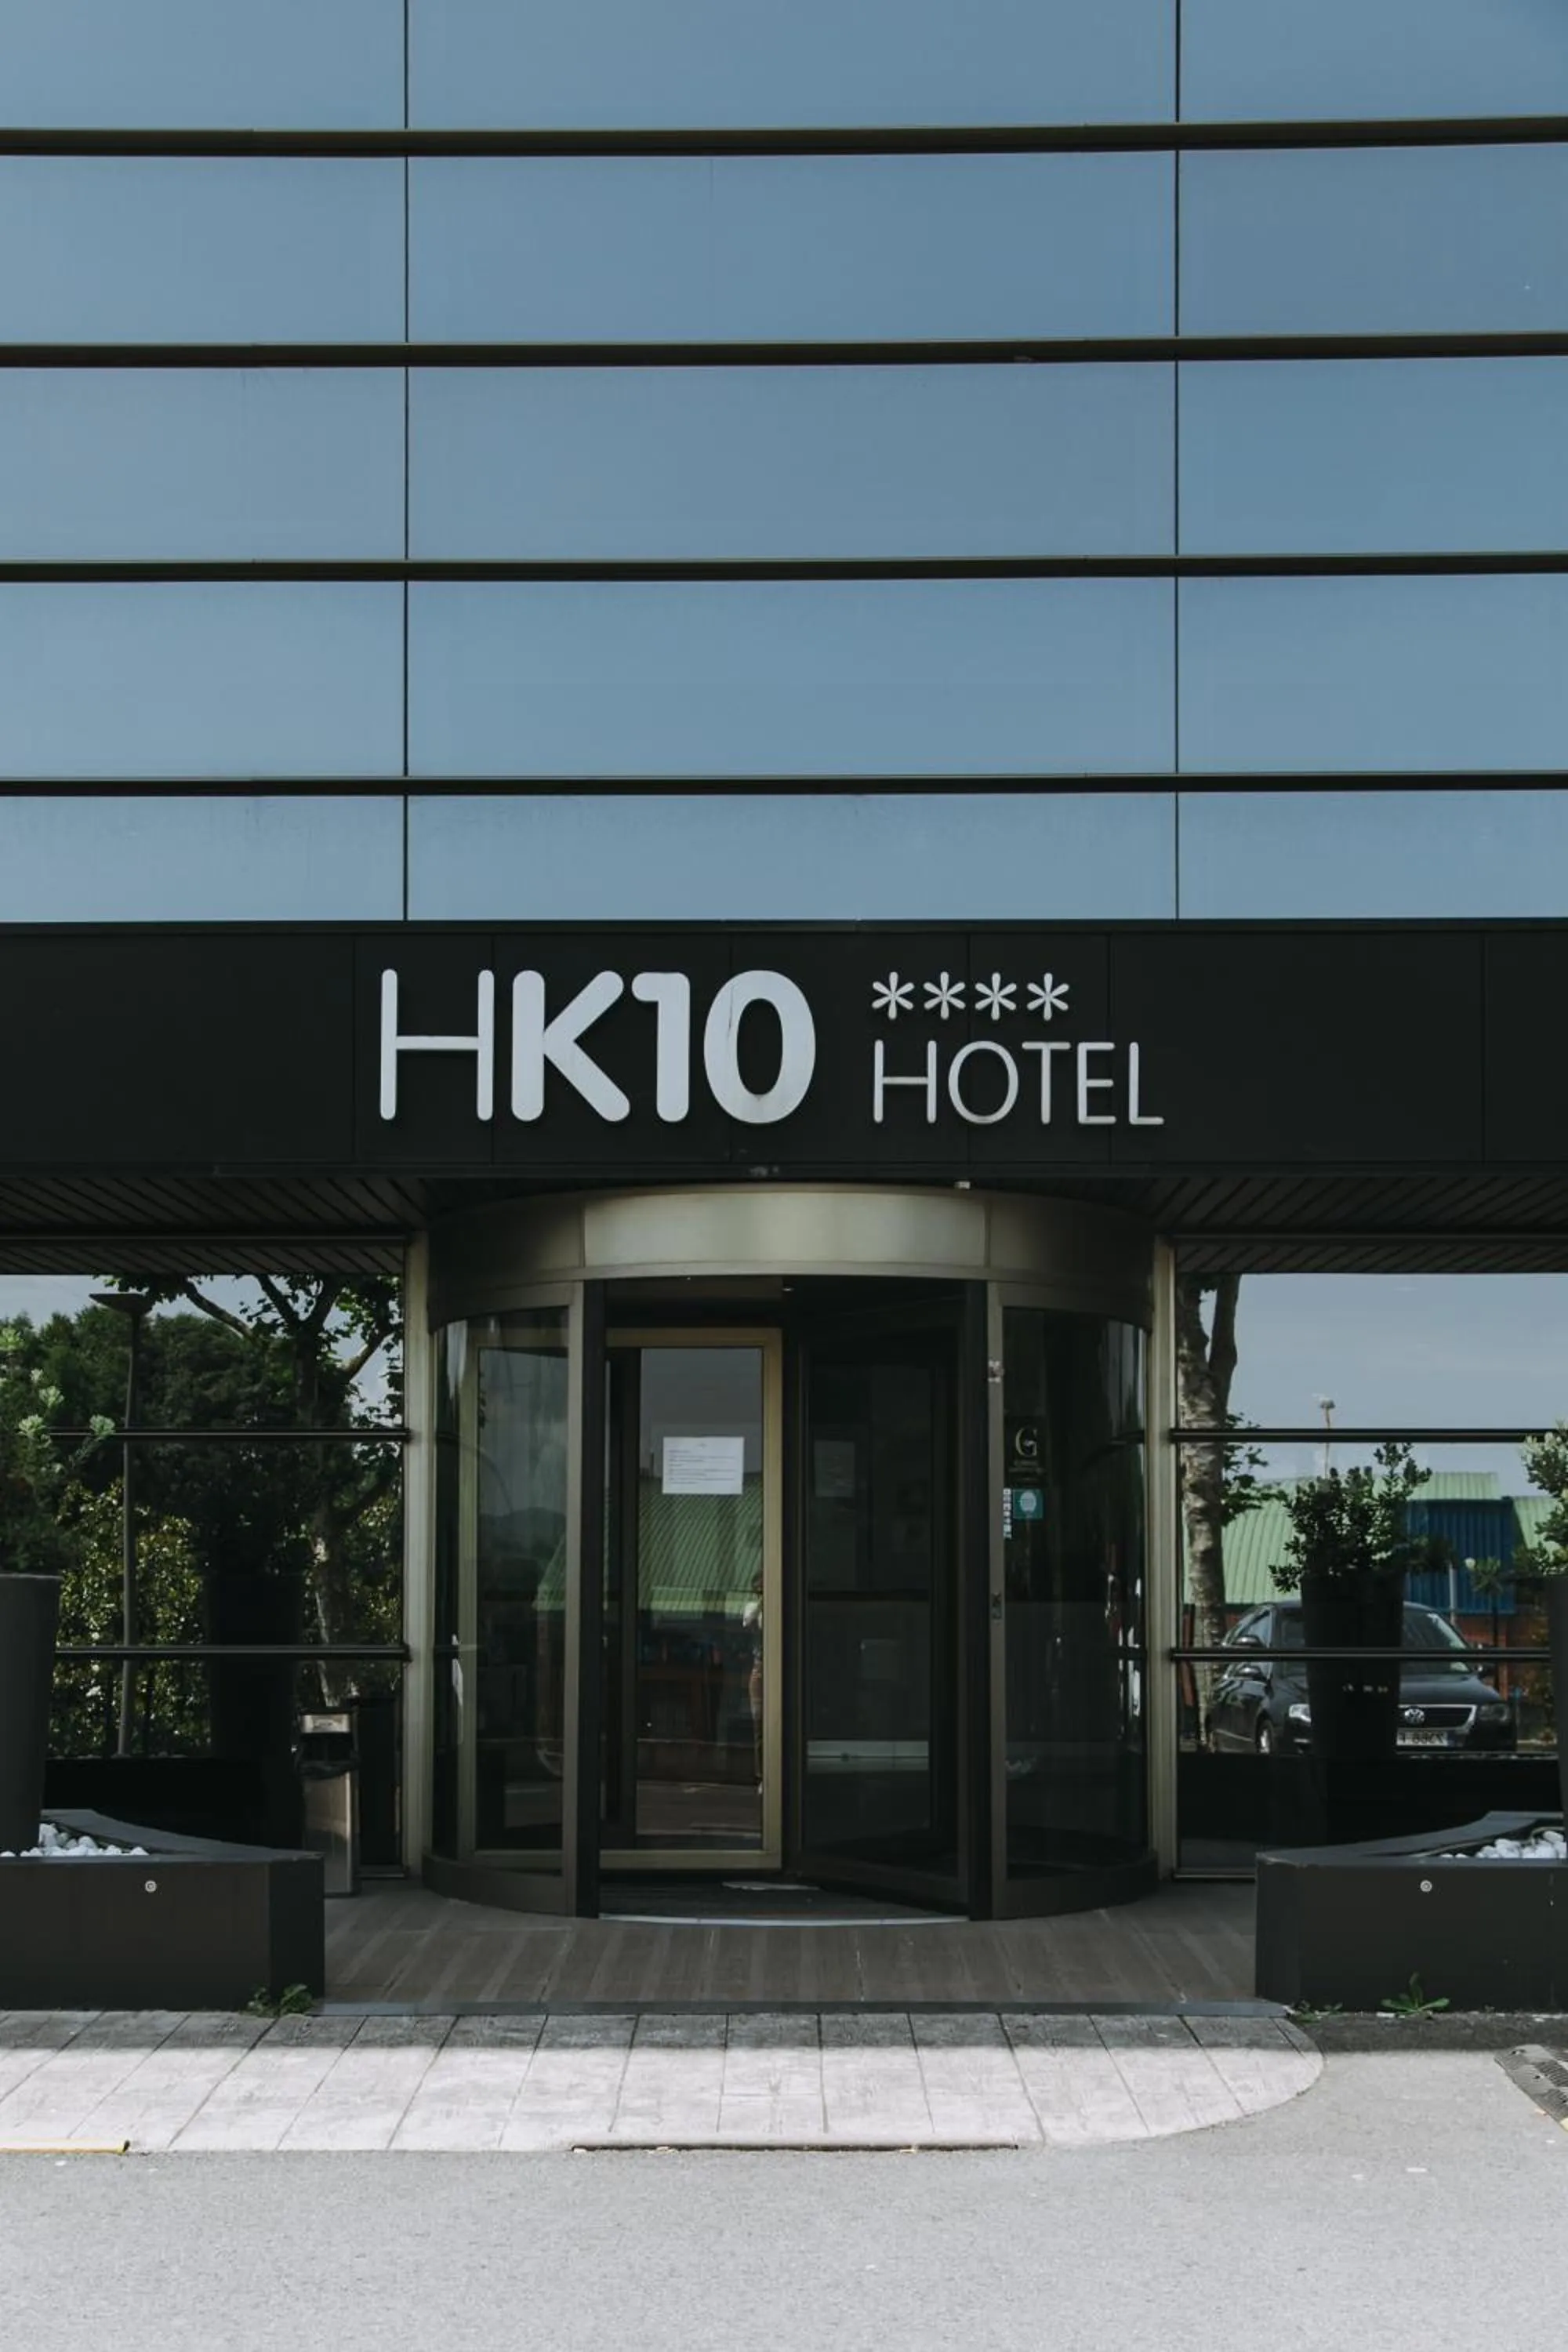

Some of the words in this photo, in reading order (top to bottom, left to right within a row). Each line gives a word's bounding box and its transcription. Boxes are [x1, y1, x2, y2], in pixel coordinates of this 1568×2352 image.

[379, 969, 816, 1123] HK10
[873, 1040, 1164, 1125] HOTEL
[1015, 1427, 1038, 1457] G
